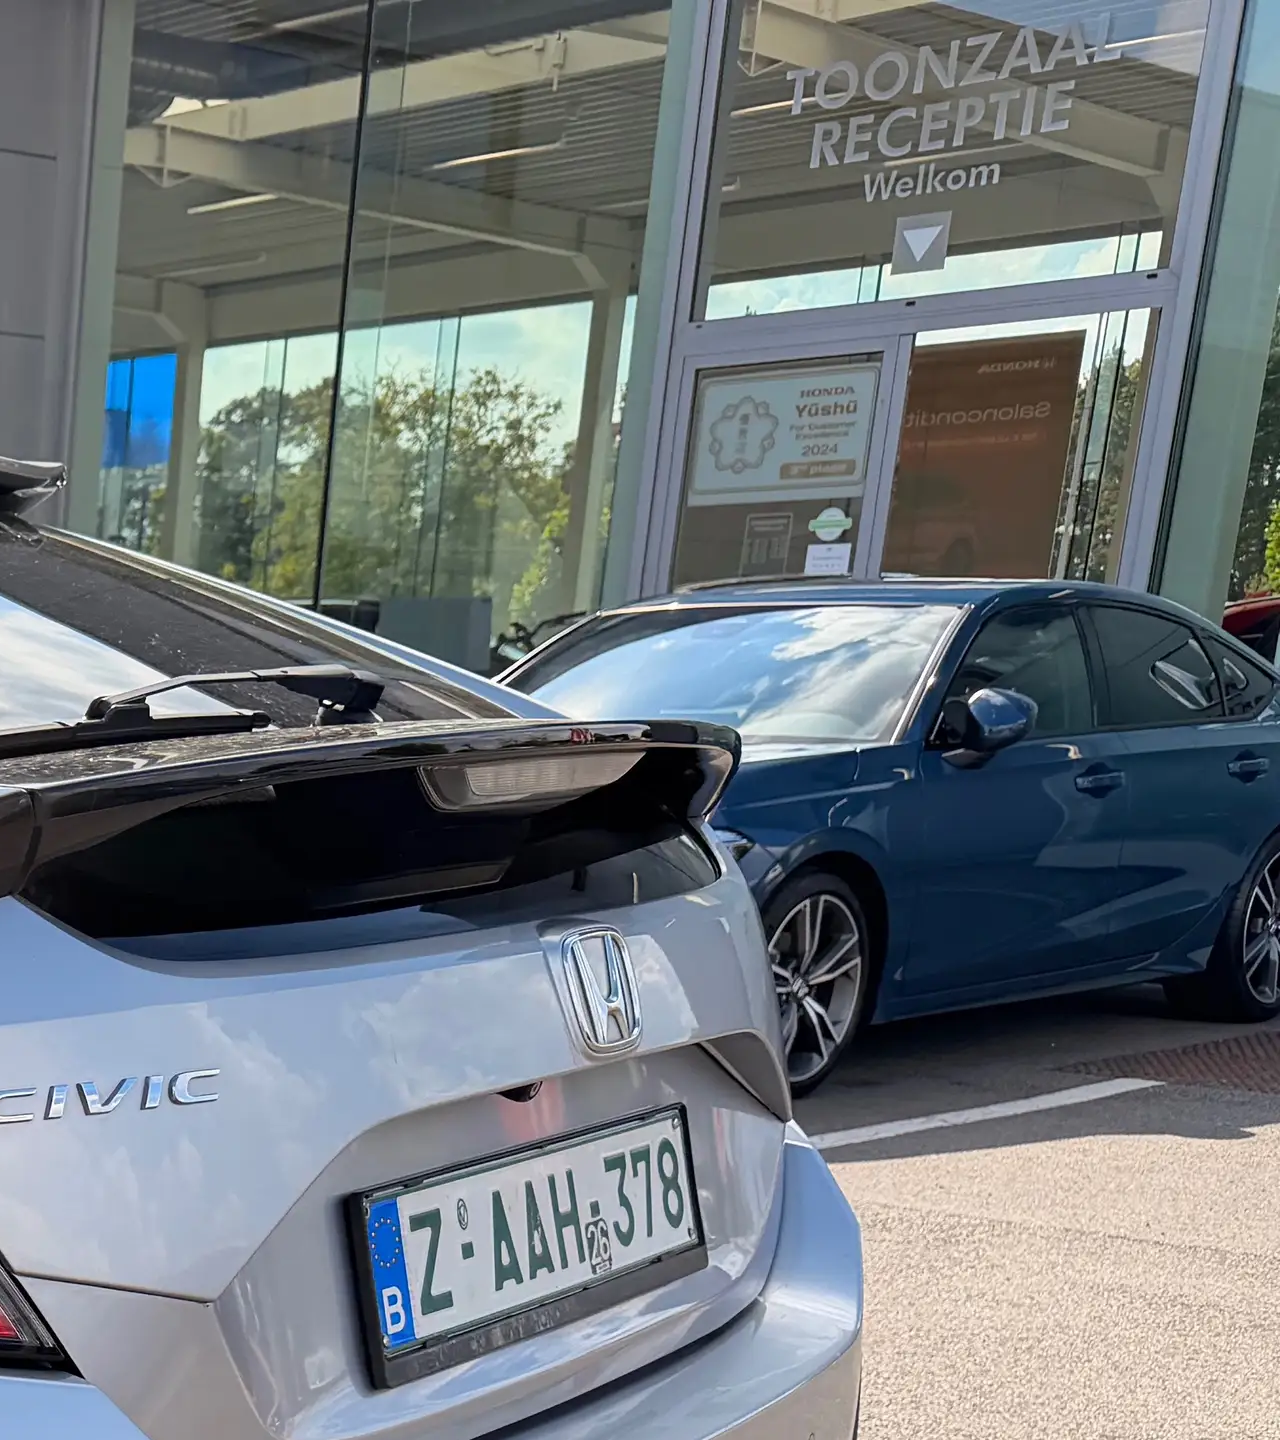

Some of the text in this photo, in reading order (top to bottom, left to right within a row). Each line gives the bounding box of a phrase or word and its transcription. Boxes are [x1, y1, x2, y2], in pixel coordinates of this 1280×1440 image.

[785, 12, 1127, 115] TOONZAAL
[809, 80, 1077, 169] RECEPTIE
[862, 162, 1000, 203] Welkom
[799, 386, 855, 399] HONDA
[801, 443, 838, 458] 2024
[382, 1285, 407, 1335] B
